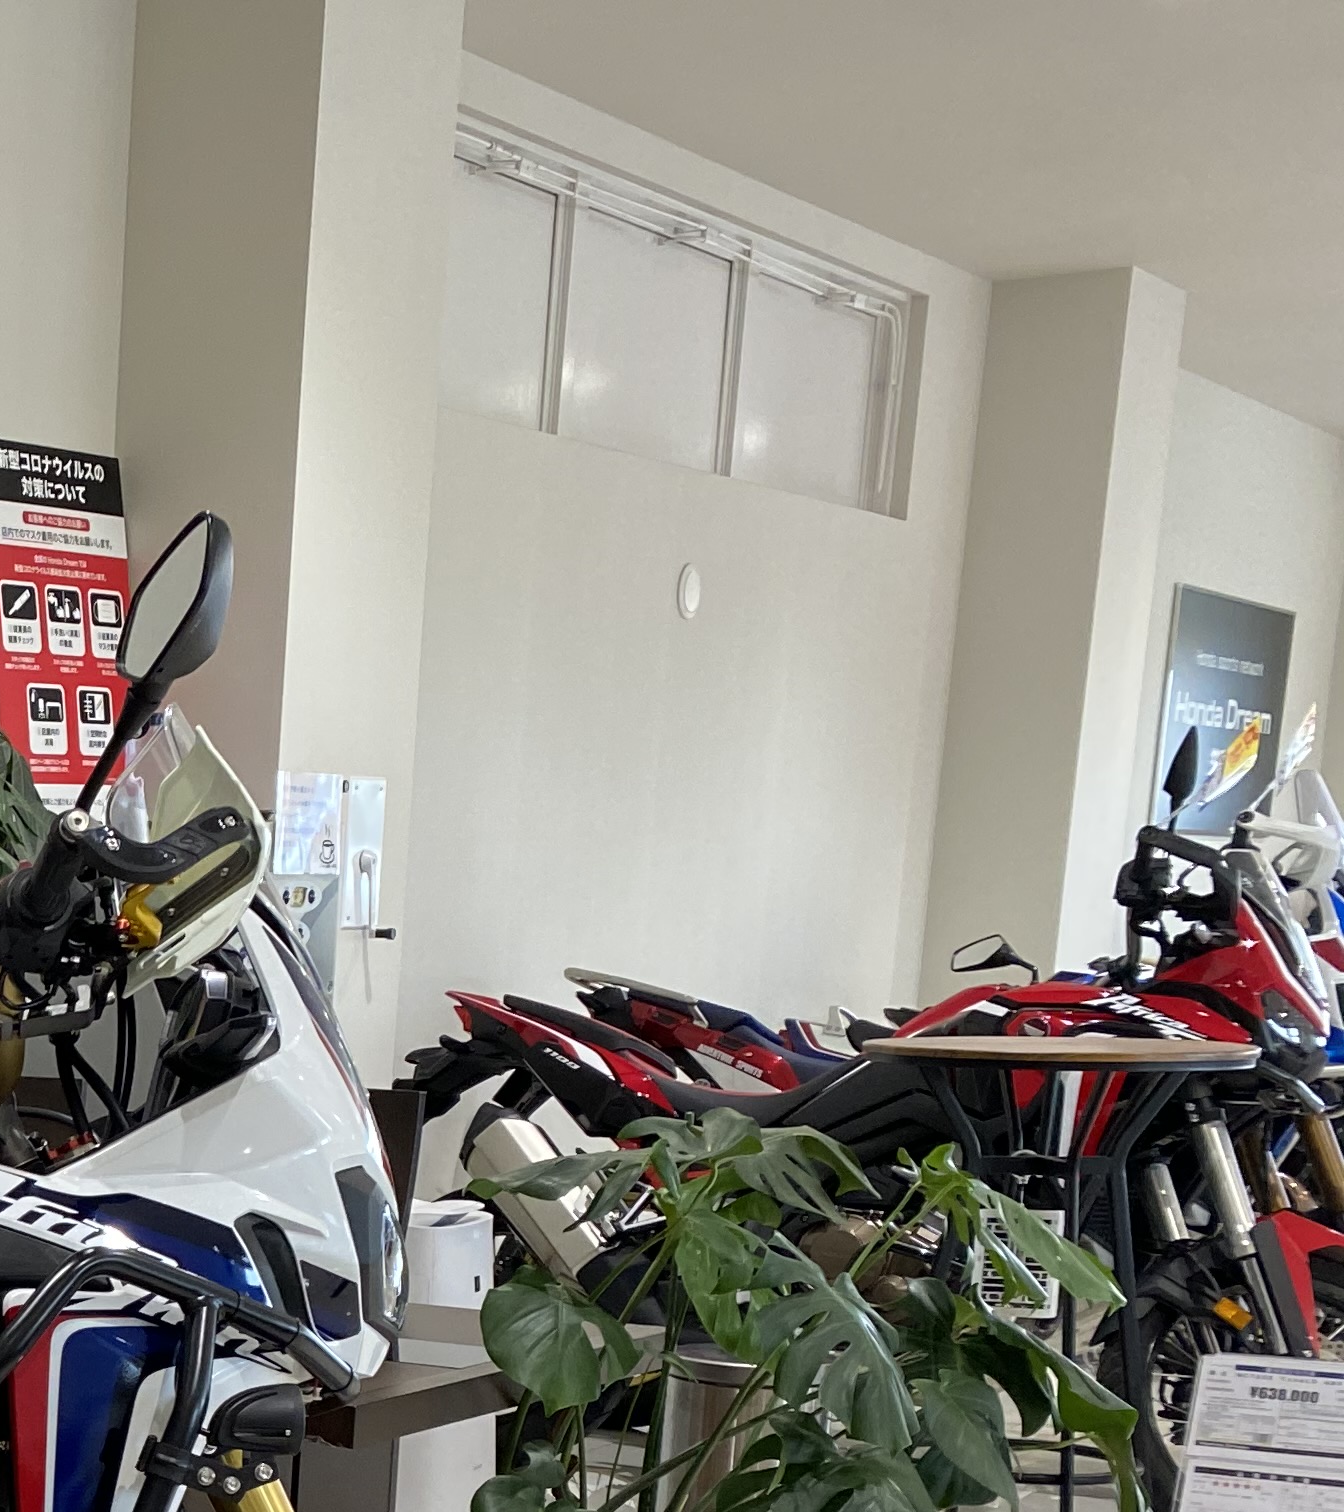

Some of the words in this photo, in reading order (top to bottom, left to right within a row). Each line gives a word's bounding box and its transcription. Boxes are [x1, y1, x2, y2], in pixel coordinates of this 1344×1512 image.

[21, 475, 86, 503] 対策について
[1175, 691, 1224, 728] Honda
